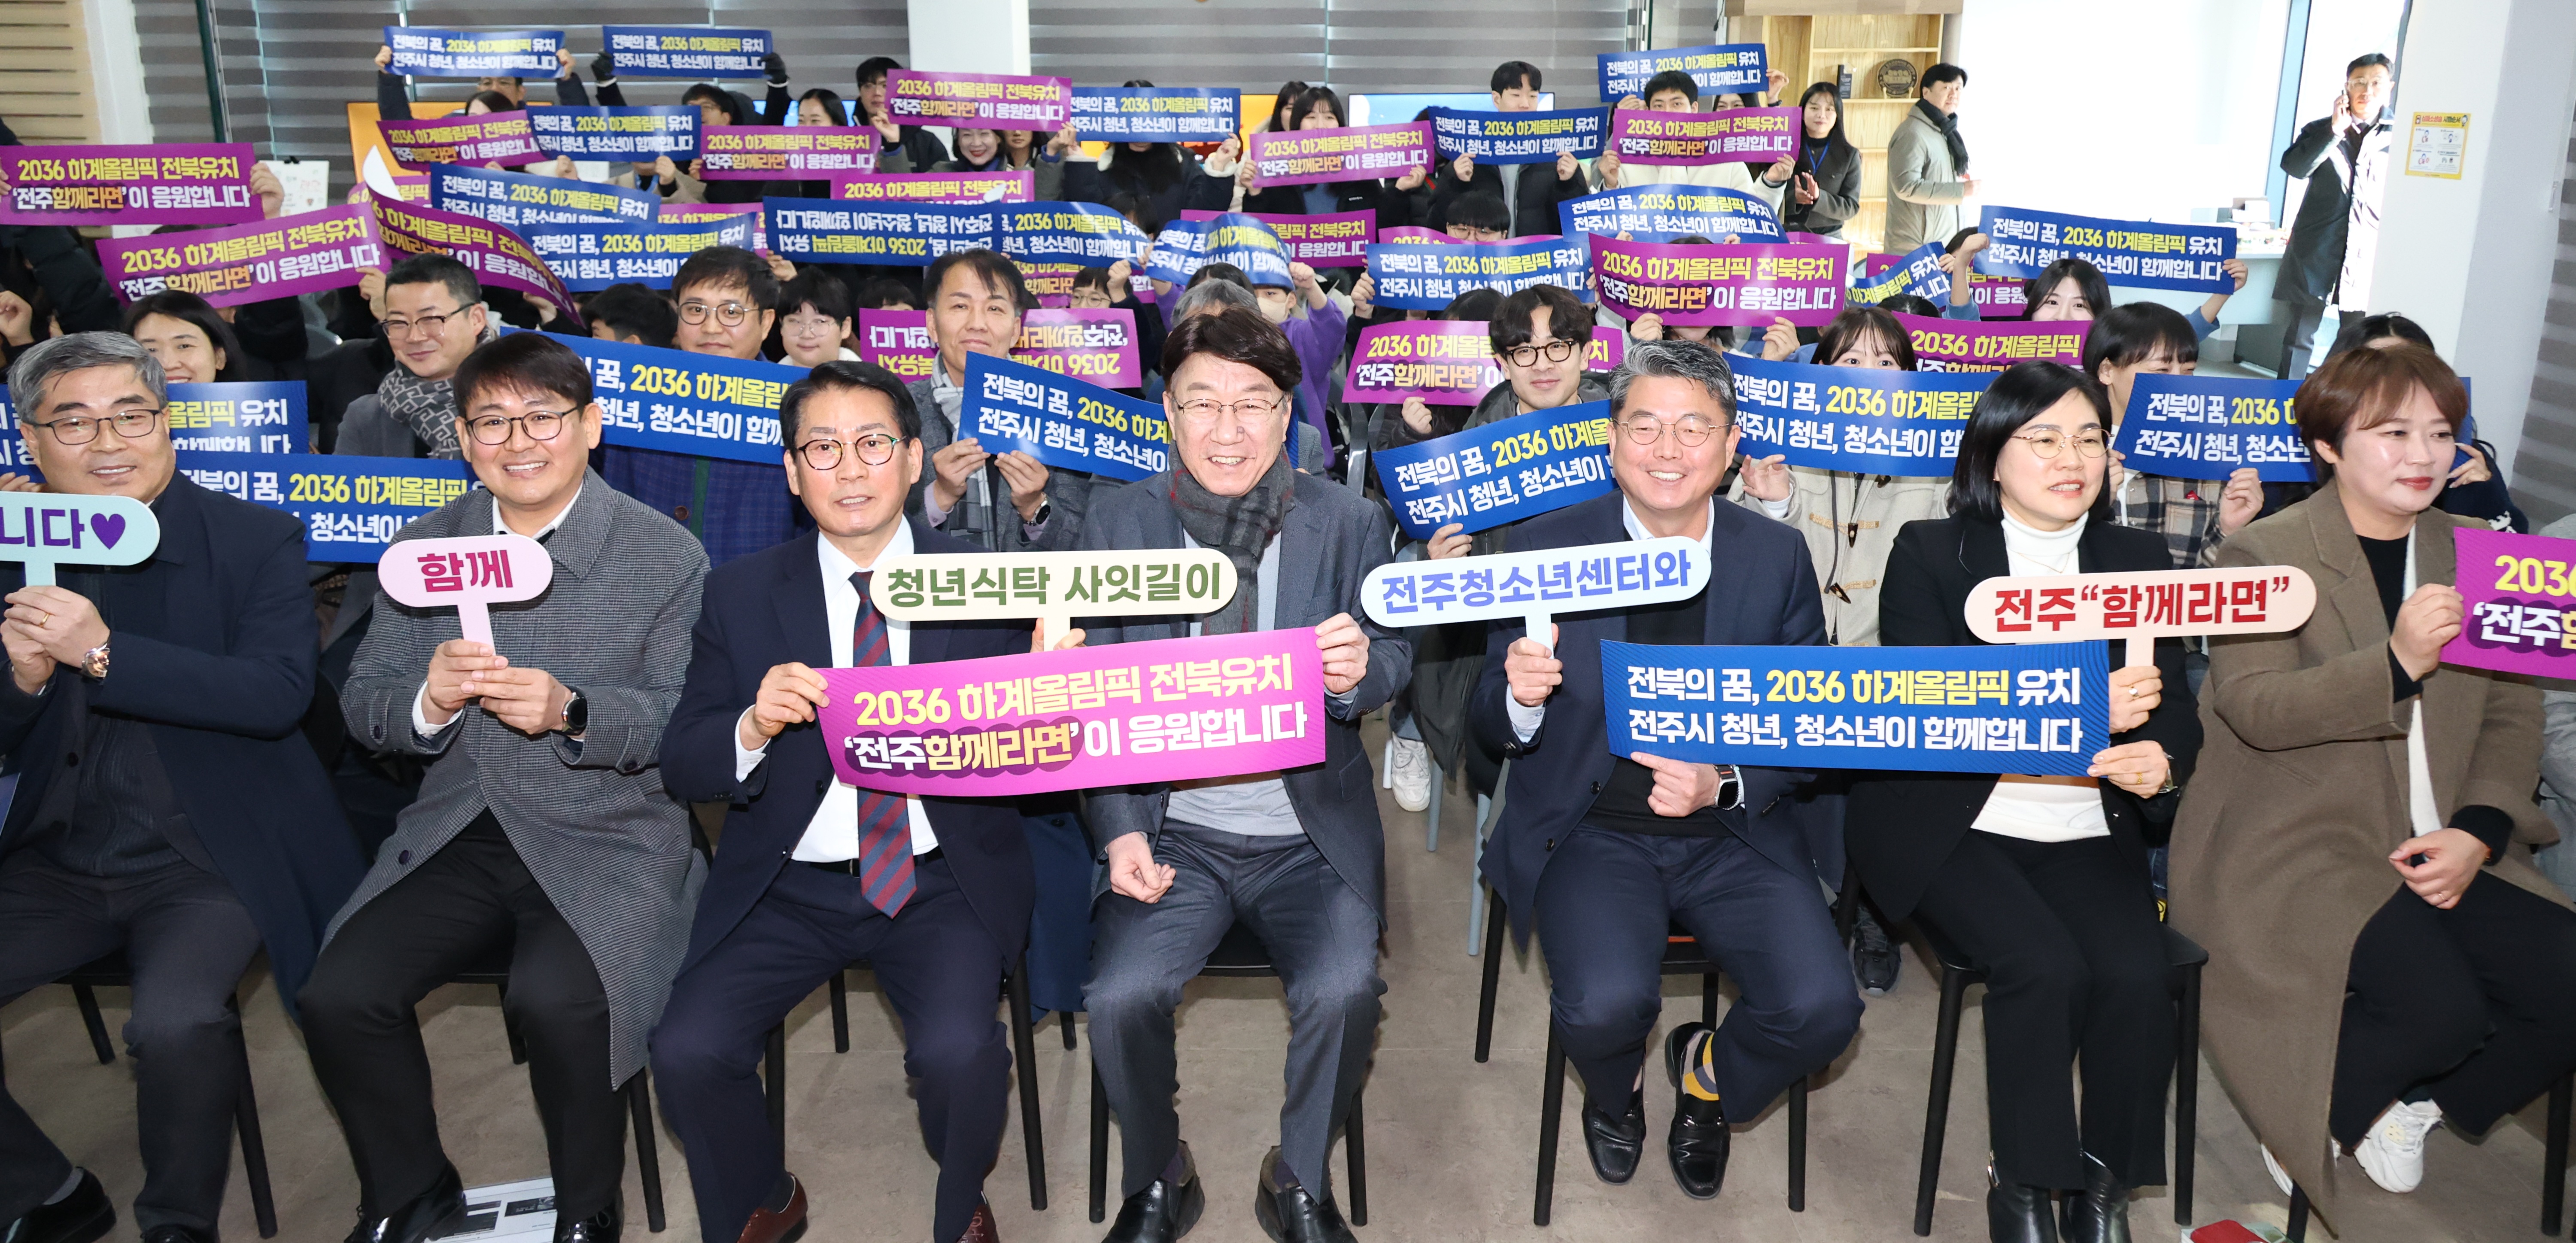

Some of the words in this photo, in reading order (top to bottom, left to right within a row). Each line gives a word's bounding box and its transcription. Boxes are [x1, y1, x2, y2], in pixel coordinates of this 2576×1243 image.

[1607, 60, 1638, 76] 전북의
[1640, 59, 1653, 75] 꿈,
[1685, 52, 1737, 70] 하계올림픽
[1739, 51, 1759, 66] 유치
[897, 79, 931, 95] 2036
[934, 81, 1003, 99] 하계올림픽
[1607, 78, 1638, 94] 전주시
[1710, 69, 1761, 86] 함께합니다
[1104, 97, 1119, 114] 꿈,
[1121, 97, 1150, 112] 2036
[1152, 97, 1208, 113] 하계올림픽
[1210, 97, 1233, 113] 유치
[1103, 117, 1129, 134] 청년,
[1131, 117, 1176, 133] 청소년이
[1178, 117, 1233, 133] 함께합니다
[1436, 116, 1465, 134] 전북의
[1468, 119, 1482, 137] 꿈,
[1485, 121, 1513, 136] 2036
[1516, 118, 1573, 136] 하계올림픽
[1576, 116, 1598, 131] 유치
[1627, 119, 1662, 136] 2036
[1665, 118, 1730, 137] 하계올림픽
[1733, 116, 1789, 133] 전북유치
[707, 135, 742, 149] 2036
[1263, 140, 1299, 157] 2036
[1301, 134, 1367, 155] 하계올림픽
[1370, 130, 1422, 149] 전북유치
[1467, 140, 1492, 156] 청년,
[1495, 140, 1539, 155] 청소년이
[1542, 135, 1598, 153] 함께합니다
[1619, 138, 1721, 156] ‘전주함께라면’이
[1723, 136, 1792, 152] 응원합니다
[18, 159, 64, 180] 2036
[67, 158, 158, 180] 하계올림픽
[161, 157, 239, 179] 전북유치
[1258, 153, 1359, 176] ‘전주함께라면’이
[1361, 149, 1428, 168] 응원합니다
[13, 185, 149, 210] ‘전주함께라면’이
[152, 185, 250, 208] 응원합니다
[442, 175, 486, 197] 전북의
[489, 181, 507, 202] 꿈,
[844, 183, 884, 198] 2036
[887, 181, 960, 197] 하계올림픽
[1572, 197, 1615, 214] 전북의
[1618, 195, 1638, 212] 꿈,
[1639, 195, 1675, 209] 2036
[1678, 195, 1745, 213] 하계올림픽
[1746, 201, 1772, 220] 유치
[386, 208, 494, 248] 하계올림픽
[1015, 213, 1052, 231] 2036
[1309, 220, 1365, 238] 전북유치
[1574, 215, 1617, 232] 전주시
[1620, 216, 1652, 234] 청년,
[1654, 217, 1710, 234] 청소년이
[1711, 217, 1778, 237] 함께합니다
[121, 247, 181, 273] 2036
[184, 231, 285, 266] 하계올림픽
[288, 216, 368, 250] 전북유치
[532, 235, 576, 255] 전북의
[579, 235, 599, 255] 꿈,
[602, 235, 642, 252] 2036
[720, 225, 745, 243] 유치
[1993, 218, 2039, 240] 전북의
[2041, 223, 2060, 245] 꿈,
[2063, 226, 2103, 247] 2036
[2107, 231, 2185, 253] 하계올림픽
[2189, 237, 2222, 255] 유치
[279, 243, 380, 280] 응원합니다
[579, 260, 614, 280] 청년,
[616, 260, 677, 279] 청소년이
[1380, 254, 1422, 274] 전북의
[1424, 255, 1442, 276] 꿈,
[1444, 256, 1479, 274] 2036
[1480, 252, 1551, 275] 하계올림픽
[1554, 248, 1583, 268] 유치
[1602, 251, 1642, 277] 2036
[1647, 257, 1751, 280] 하계올림픽
[1758, 258, 1833, 280] 전북유치
[1911, 253, 1941, 281] 유치
[1989, 243, 2034, 266] 전주시
[2141, 258, 2222, 281] 함께합니다
[1380, 278, 1422, 298] 전주시
[1425, 279, 1455, 300] 청년,
[1600, 275, 1734, 309] ‘전주함께라면’이
[1740, 287, 1836, 310] 응원합니다
[1367, 337, 1412, 358] 2036
[1911, 330, 1968, 356] 2036
[1974, 334, 2080, 358] 하계올림픽
[596, 359, 626, 392] 꿈,
[630, 365, 691, 396] 2036
[983, 373, 1043, 410] 전북의
[1048, 389, 1073, 419] 꿈,
[1077, 397, 1128, 429] 2036
[1734, 374, 1789, 409] 전북의
[1793, 382, 1821, 414] 꿈,
[1826, 386, 1886, 416] 2036
[241, 400, 287, 426] 유치
[650, 404, 738, 442] 청소년이
[2147, 392, 2204, 423] 전북의
[2207, 395, 2228, 428] 꿈,
[2232, 397, 2277, 424] 2036
[979, 408, 1039, 443] 전주시
[1044, 421, 1088, 457] 청년,
[1789, 420, 1838, 454] 청년,
[1844, 425, 1934, 458] 청소년이
[1396, 447, 1460, 492] 전북의
[1460, 445, 1492, 477] 꿈,
[1492, 430, 1547, 468] 2036
[2136, 430, 2201, 460] 전주시
[2204, 435, 2243, 465] 청년,
[253, 473, 284, 504] 꿈,
[289, 474, 349, 504] 2036
[1406, 486, 1468, 525] 전주시
[1470, 477, 1519, 512] 청년,
[1521, 456, 1603, 495] 청소년이
[311, 514, 401, 544] 청소년이
[417, 549, 513, 593] 함께
[888, 566, 1050, 607] 청년식탁
[1065, 562, 1220, 604] 사잇길이
[1381, 552, 1692, 614] 전주청소년센터와
[854, 687, 950, 726] 2036
[957, 666, 1140, 722] 하계올림픽
[1151, 654, 1293, 702] 전북유치
[1627, 667, 1715, 702] 전북의
[1721, 668, 1759, 708] 꿈,
[1766, 668, 1843, 705] 2036
[1852, 668, 2008, 706] 하계올림픽
[2018, 668, 2080, 706] 유치
[846, 720, 1119, 771] ‘전주함께라면’이
[1128, 702, 1308, 754] 응원합니다
[1628, 710, 1715, 746] 전주시
[1721, 711, 1790, 751] 청년,
[1795, 714, 1914, 751] 청소년이
[1923, 715, 2083, 754] 함께합니다
